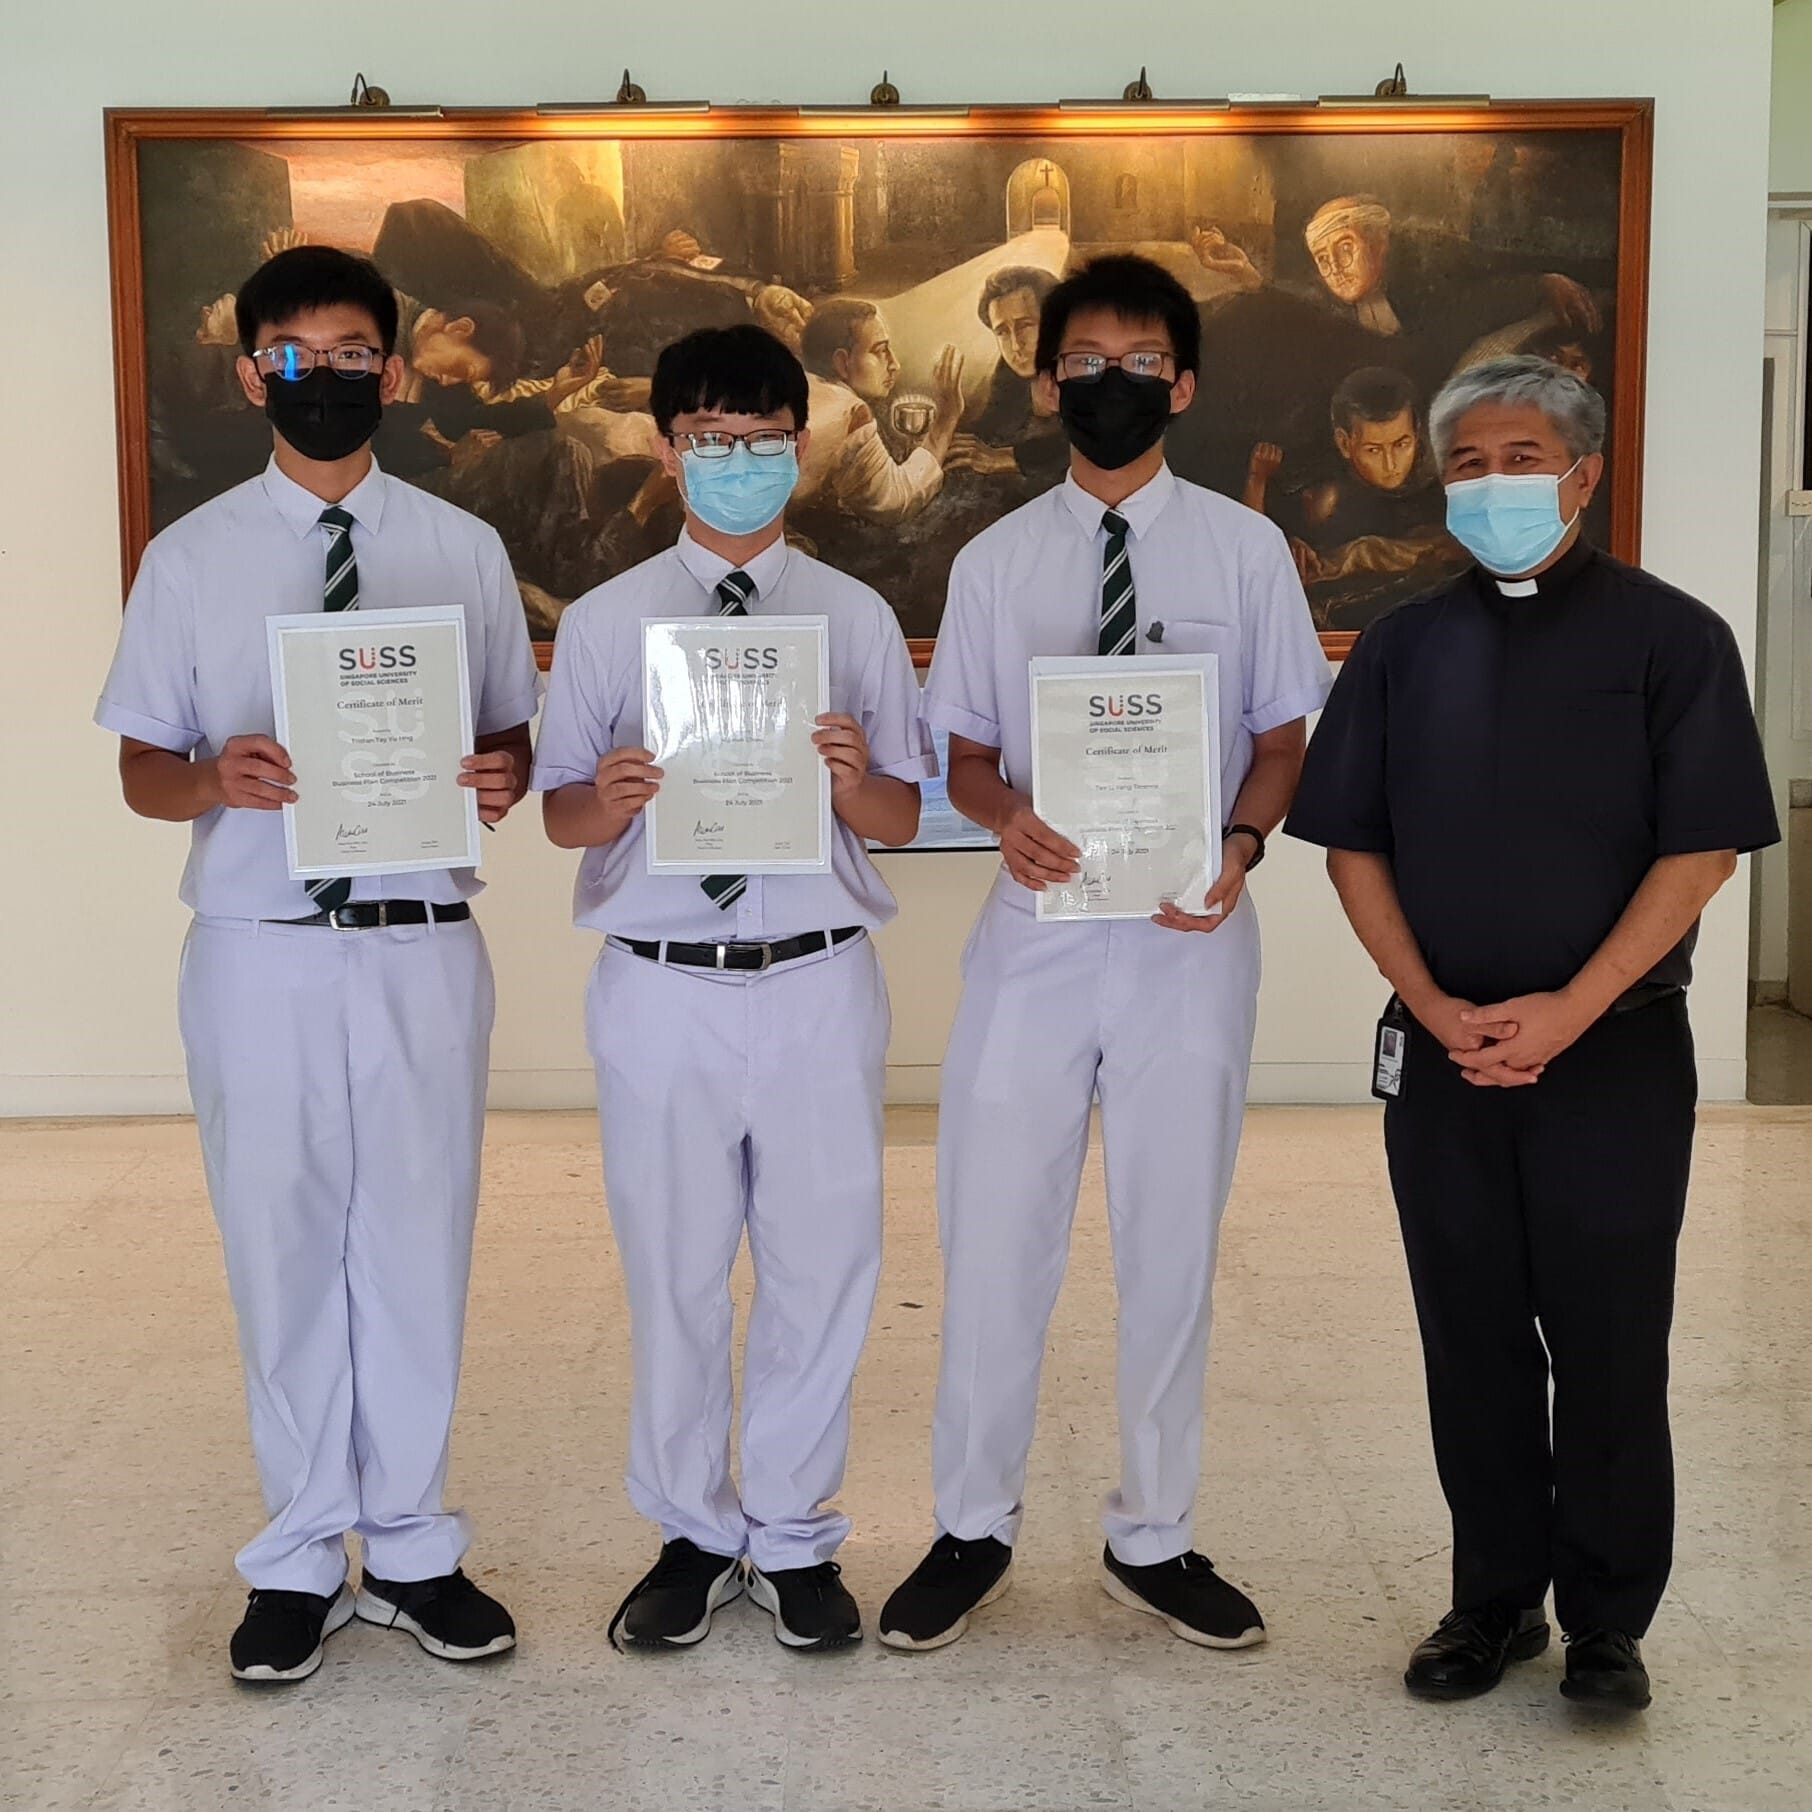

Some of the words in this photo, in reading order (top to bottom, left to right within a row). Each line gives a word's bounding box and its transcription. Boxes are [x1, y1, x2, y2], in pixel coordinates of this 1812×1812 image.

[339, 644, 417, 670] SUSS
[705, 648, 778, 670] SUSS
[339, 672, 377, 680] SINGAPORE
[378, 670, 417, 678] UNIVERSITY
[350, 679, 375, 687] SOCIAL
[376, 677, 409, 685] SCIENCES
[336, 698, 385, 710] Certificate
[386, 696, 397, 706] of
[398, 696, 424, 706] Merit
[1089, 693, 1163, 717] SUSS
[1089, 719, 1125, 727] SINGAPORE
[1126, 718, 1162, 726] UNIVERSITY
[1085, 746, 1130, 756] Certificate
[1132, 744, 1142, 753] of
[1144, 744, 1168, 754] Merit
[385, 769, 415, 777] Business
[379, 776, 421, 784] Competition
